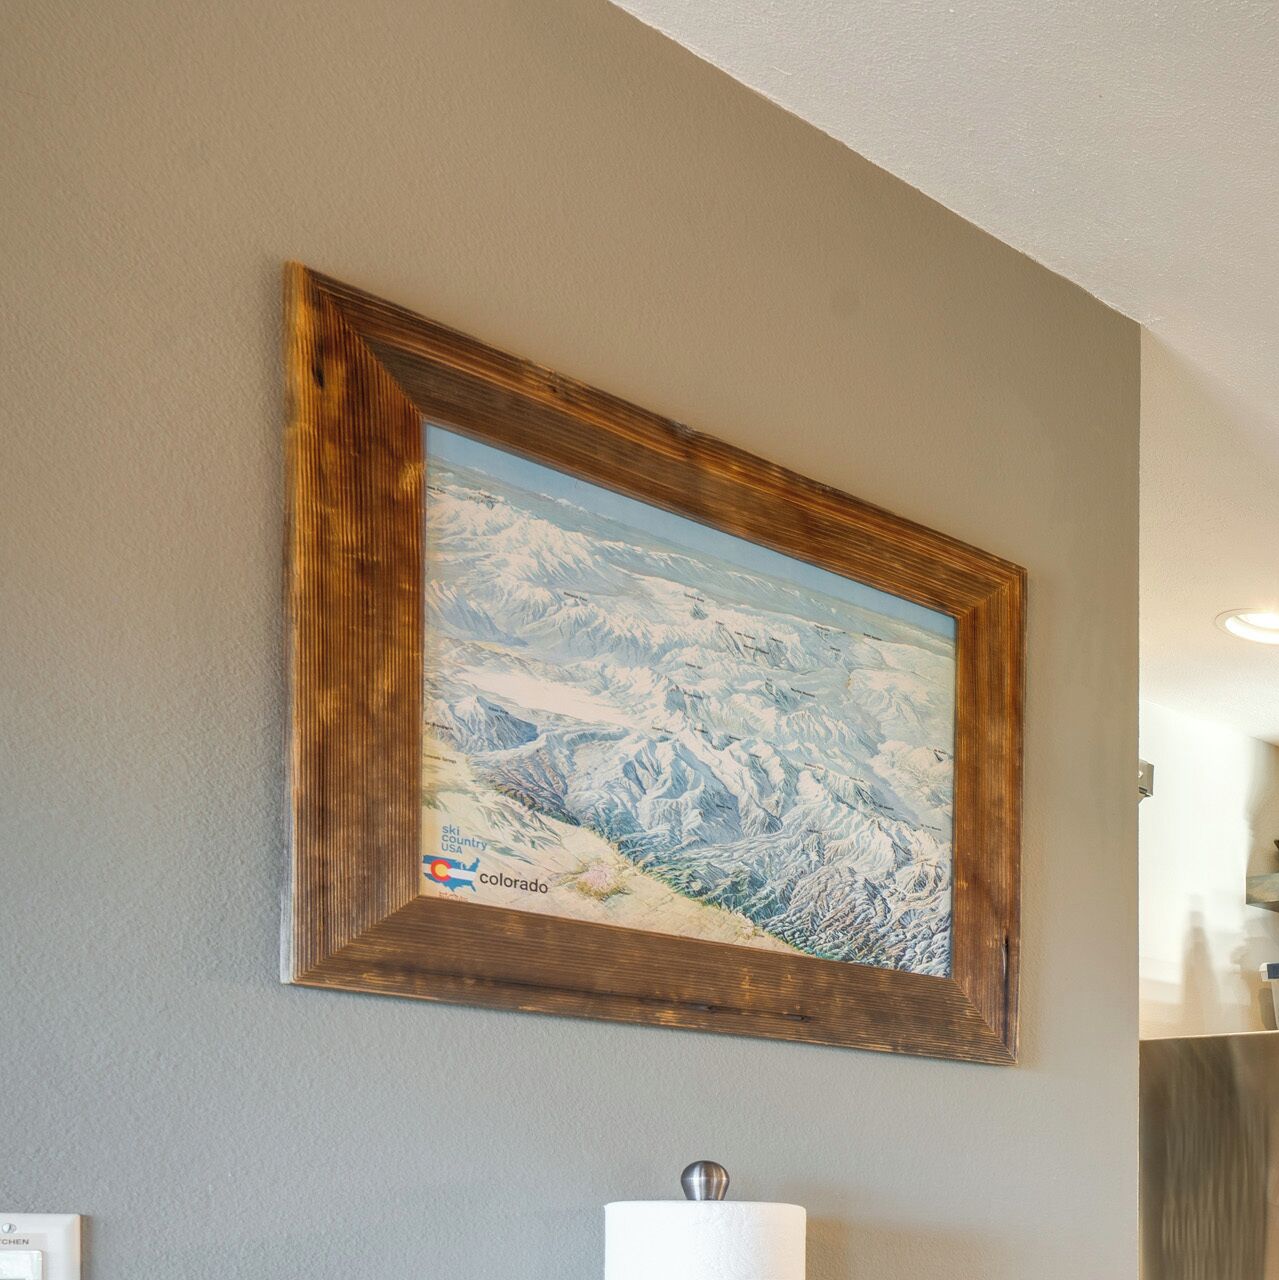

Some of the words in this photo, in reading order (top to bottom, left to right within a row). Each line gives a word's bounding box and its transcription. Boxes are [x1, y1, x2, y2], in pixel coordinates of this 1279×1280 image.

[442, 825, 460, 836] ski
[441, 833, 488, 851] country
[441, 842, 463, 855] USA
[479, 873, 549, 894] colorado
